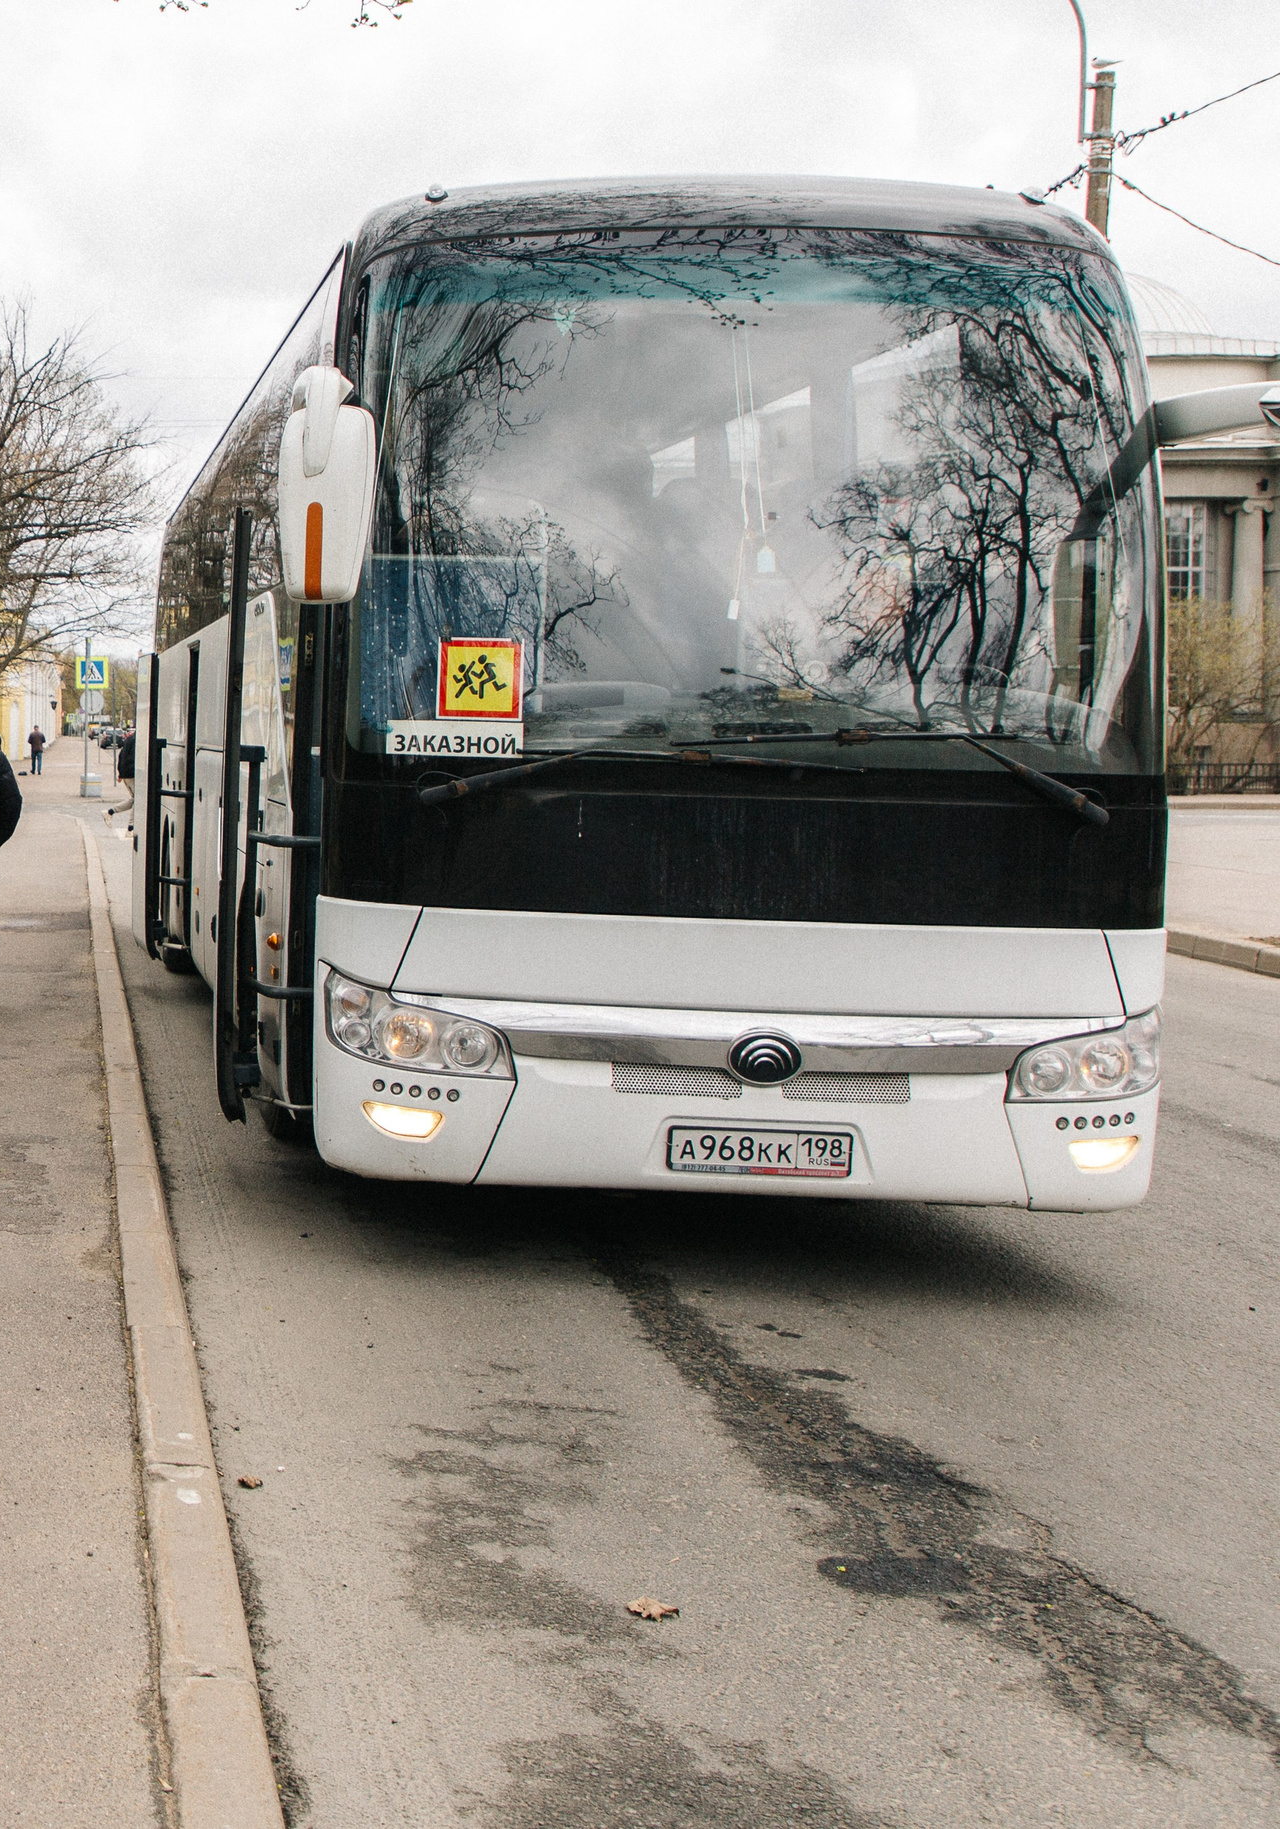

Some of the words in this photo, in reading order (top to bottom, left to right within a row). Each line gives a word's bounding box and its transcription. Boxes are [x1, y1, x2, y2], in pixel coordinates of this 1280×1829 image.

[394, 734, 516, 755] ЗАКАЗНОЙ
[679, 1134, 793, 1163] А968КК
[801, 1137, 843, 1158] 198
[809, 1157, 829, 1166] RUS
